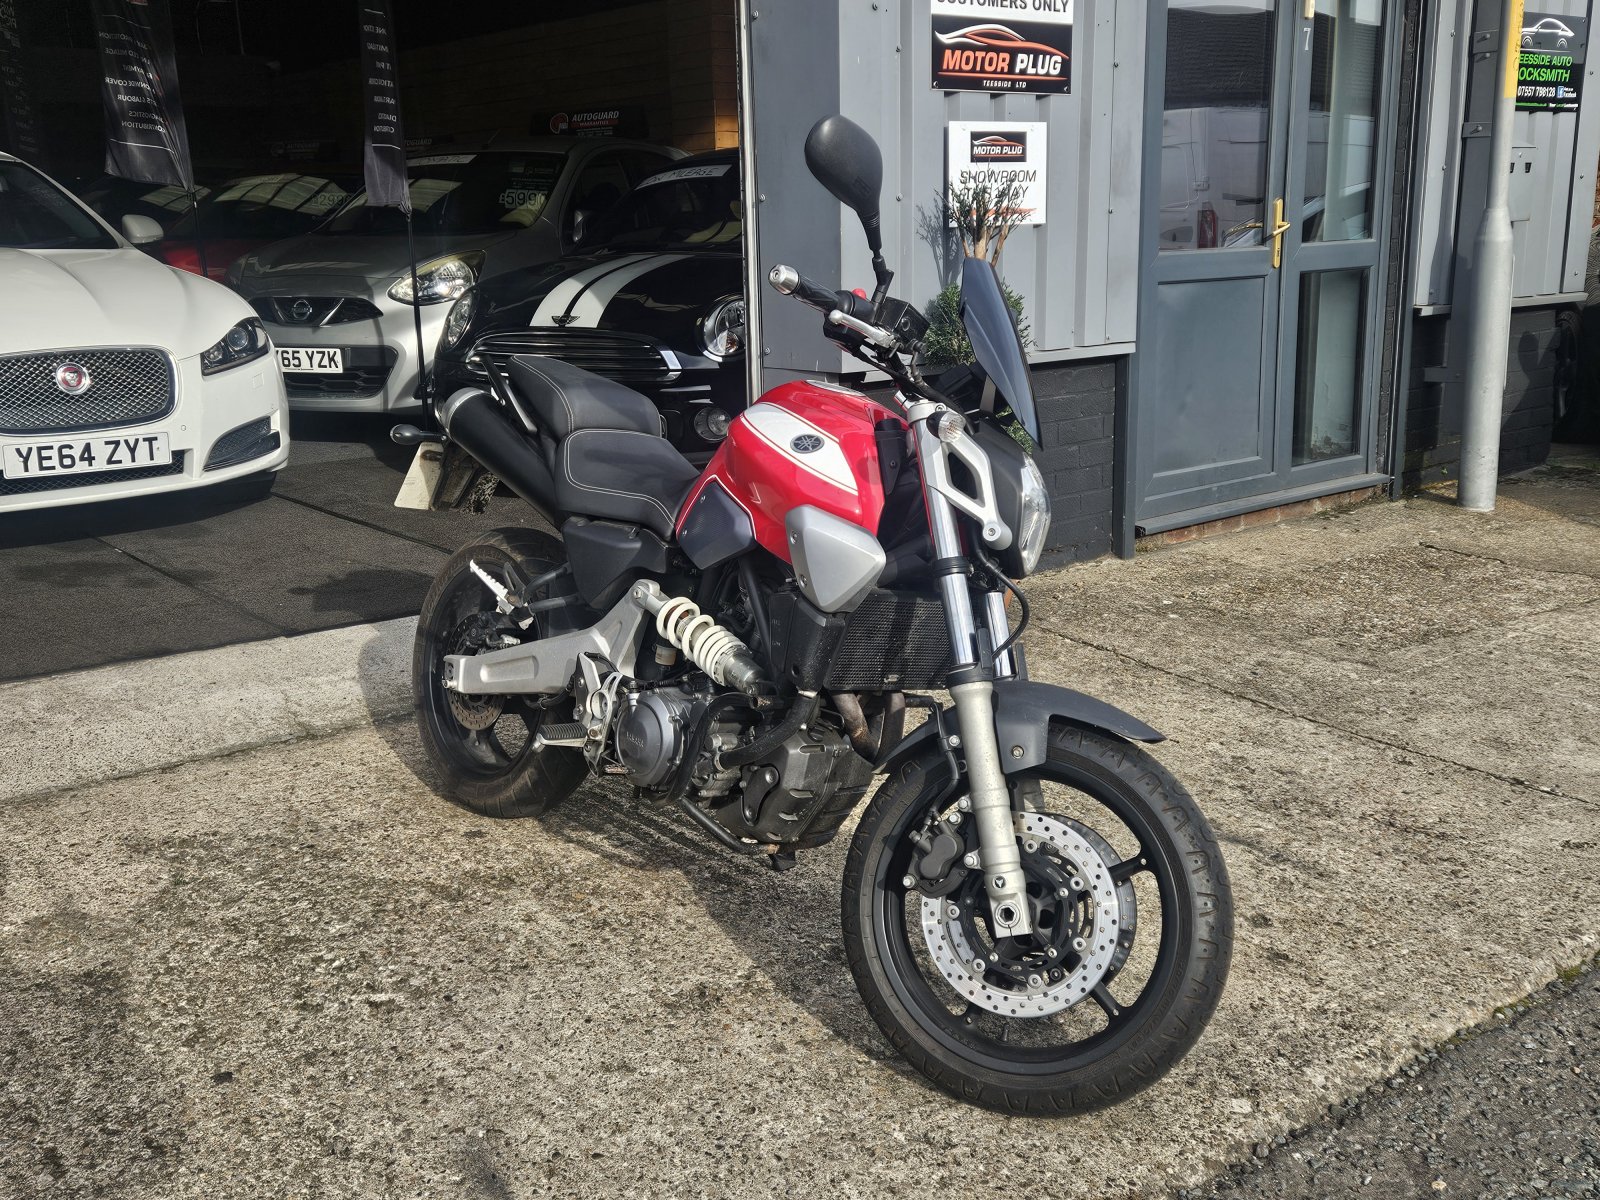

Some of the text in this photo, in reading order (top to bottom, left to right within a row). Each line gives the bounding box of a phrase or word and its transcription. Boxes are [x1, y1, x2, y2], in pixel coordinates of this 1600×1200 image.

[937, 0, 1068, 13] OMERS ONLY
[1303, 27, 1311, 51] 7
[942, 49, 1062, 76] MOTOR PLUG
[1519, 54, 1573, 67] EESSIDE AUTO
[1518, 67, 1570, 82] OCKSMITH
[1517, 85, 1535, 97] 07557
[571, 110, 620, 123] AUTOGUARD
[404, 137, 432, 147] TOGUARD
[973, 146, 1023, 155] MOTOR PLUG
[960, 169, 1037, 184] SHOWROOM
[276, 350, 339, 369] 65 YZK
[15, 436, 158, 473] YE64 ZYT
